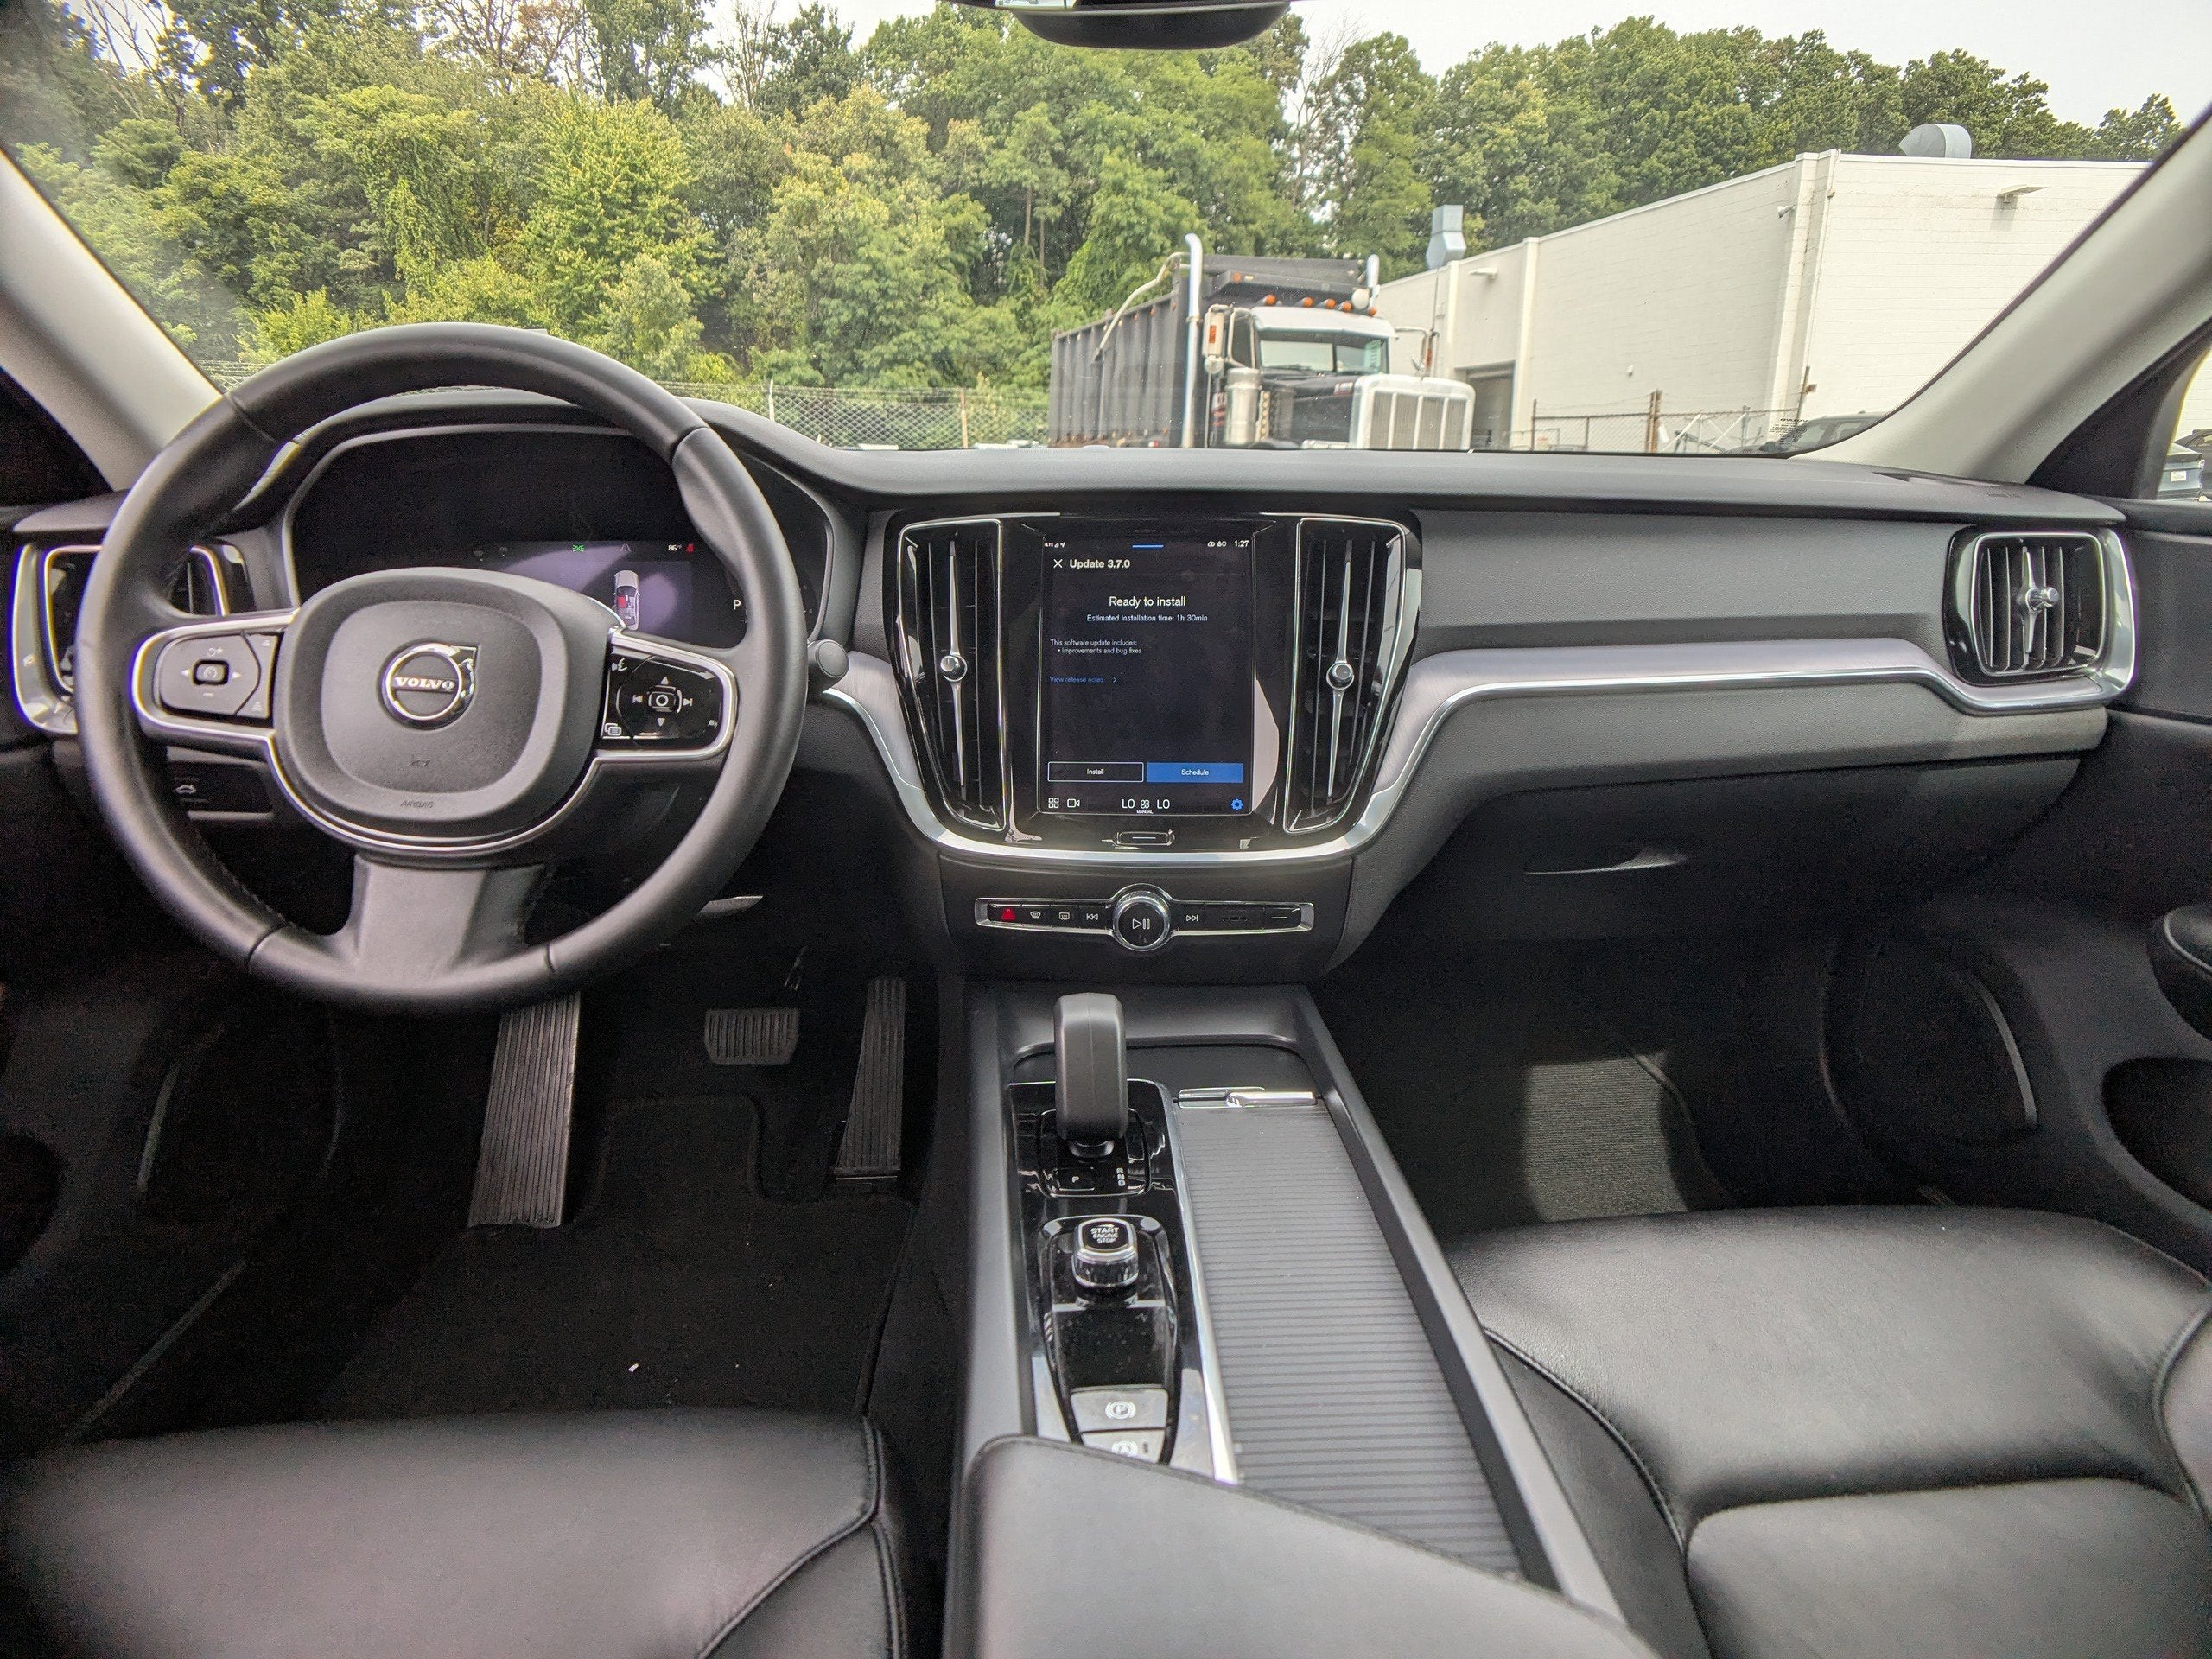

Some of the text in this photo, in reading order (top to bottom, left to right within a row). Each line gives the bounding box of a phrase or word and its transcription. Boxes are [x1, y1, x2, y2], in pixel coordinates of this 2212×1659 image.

[1070, 558, 1131, 570] Update 3.7.0
[733, 599, 741, 610] P
[1109, 595, 1186, 609] Ready to install
[1086, 613, 1120, 622] Estimated
[1121, 613, 1156, 622] installation
[1176, 613, 1185, 622] 1h
[1186, 613, 1208, 622] 30min
[1061, 646, 1103, 655] Improvements
[1116, 647, 1128, 656] bug
[394, 677, 456, 690] VOLVO
[400, 799, 435, 809] AIRBAG
[1122, 798, 1135, 809] LO
[1156, 798, 1171, 810] LO
